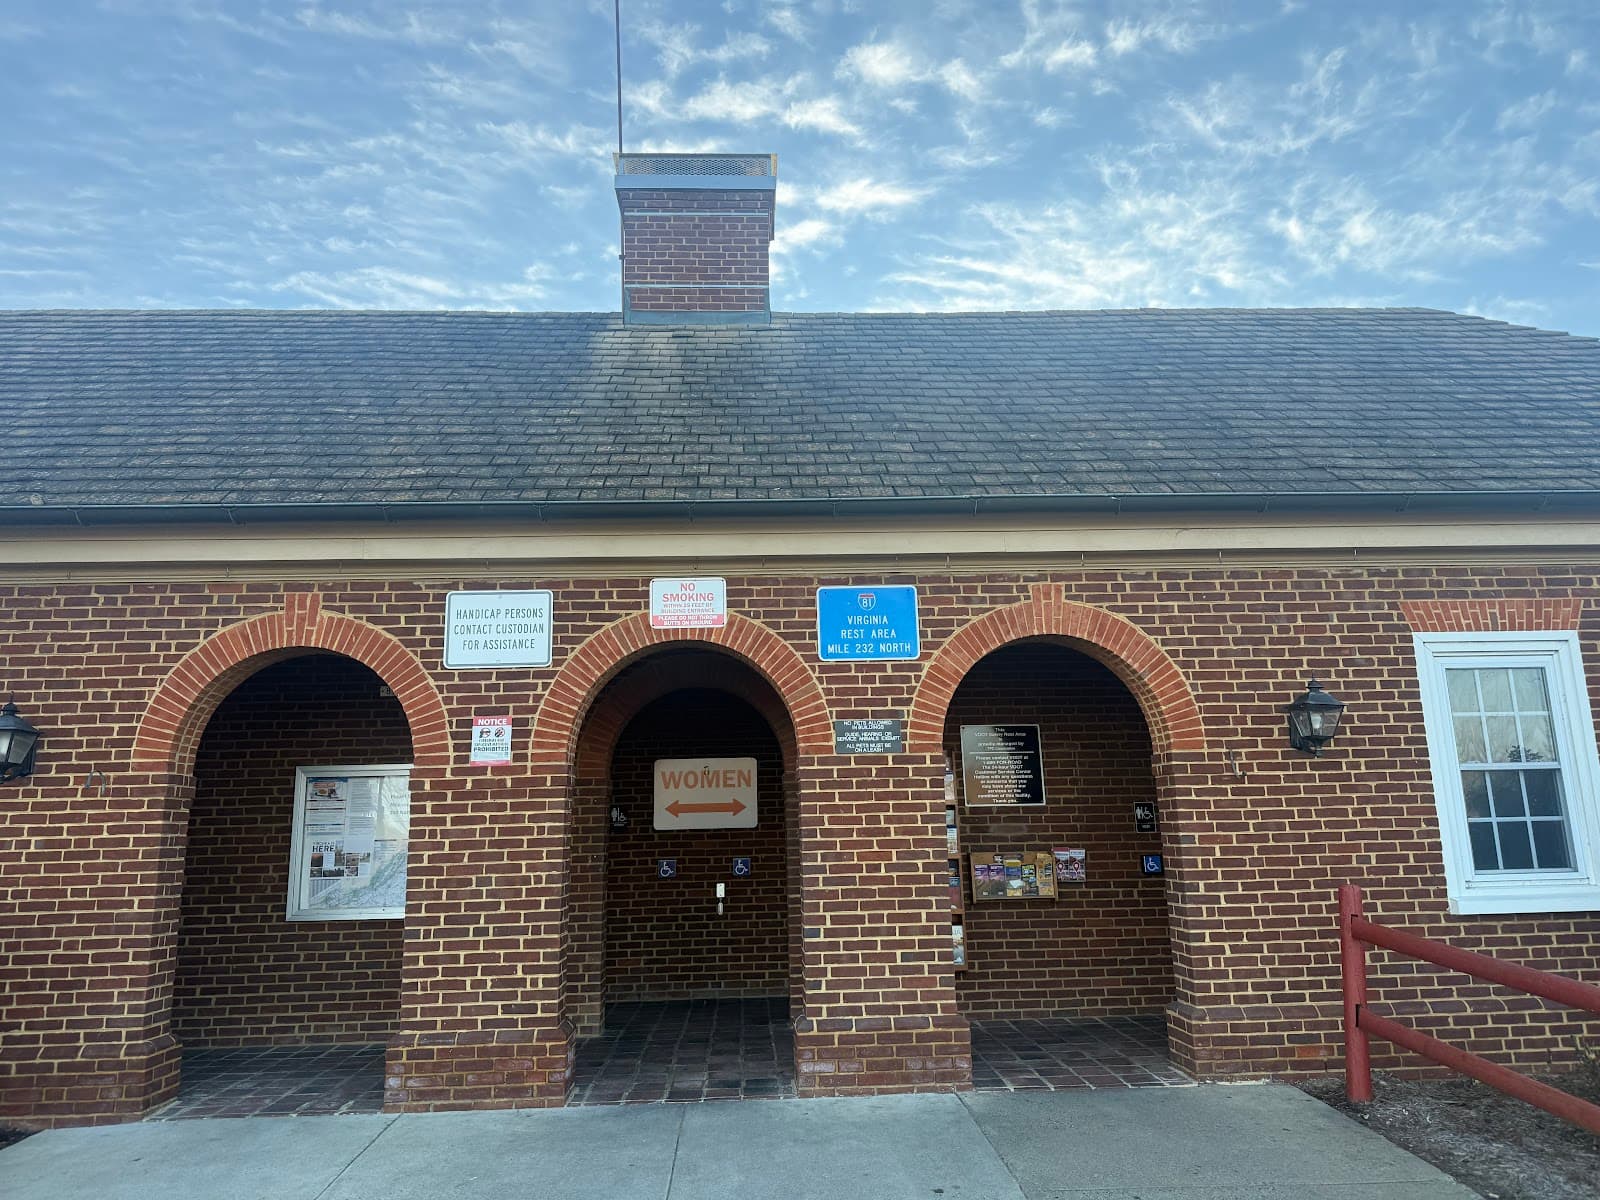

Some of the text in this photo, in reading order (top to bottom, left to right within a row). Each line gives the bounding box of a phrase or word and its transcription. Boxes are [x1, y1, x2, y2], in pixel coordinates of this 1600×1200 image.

[681, 583, 695, 592] NO
[662, 593, 714, 602] SMOKING
[862, 598, 872, 607] 81
[456, 607, 544, 620] HANDICAP PERSONS
[847, 615, 889, 625] VIRGINIA
[454, 623, 544, 635] CONTACT CUSTODIAN
[841, 628, 897, 639] REST AREA
[463, 638, 535, 650] FOR ASSISTANCE
[827, 642, 911, 654] MILE 232 NORTH
[478, 718, 508, 726] NOTICE
[660, 769, 752, 790] WOMEN
[312, 845, 335, 853] HERE
